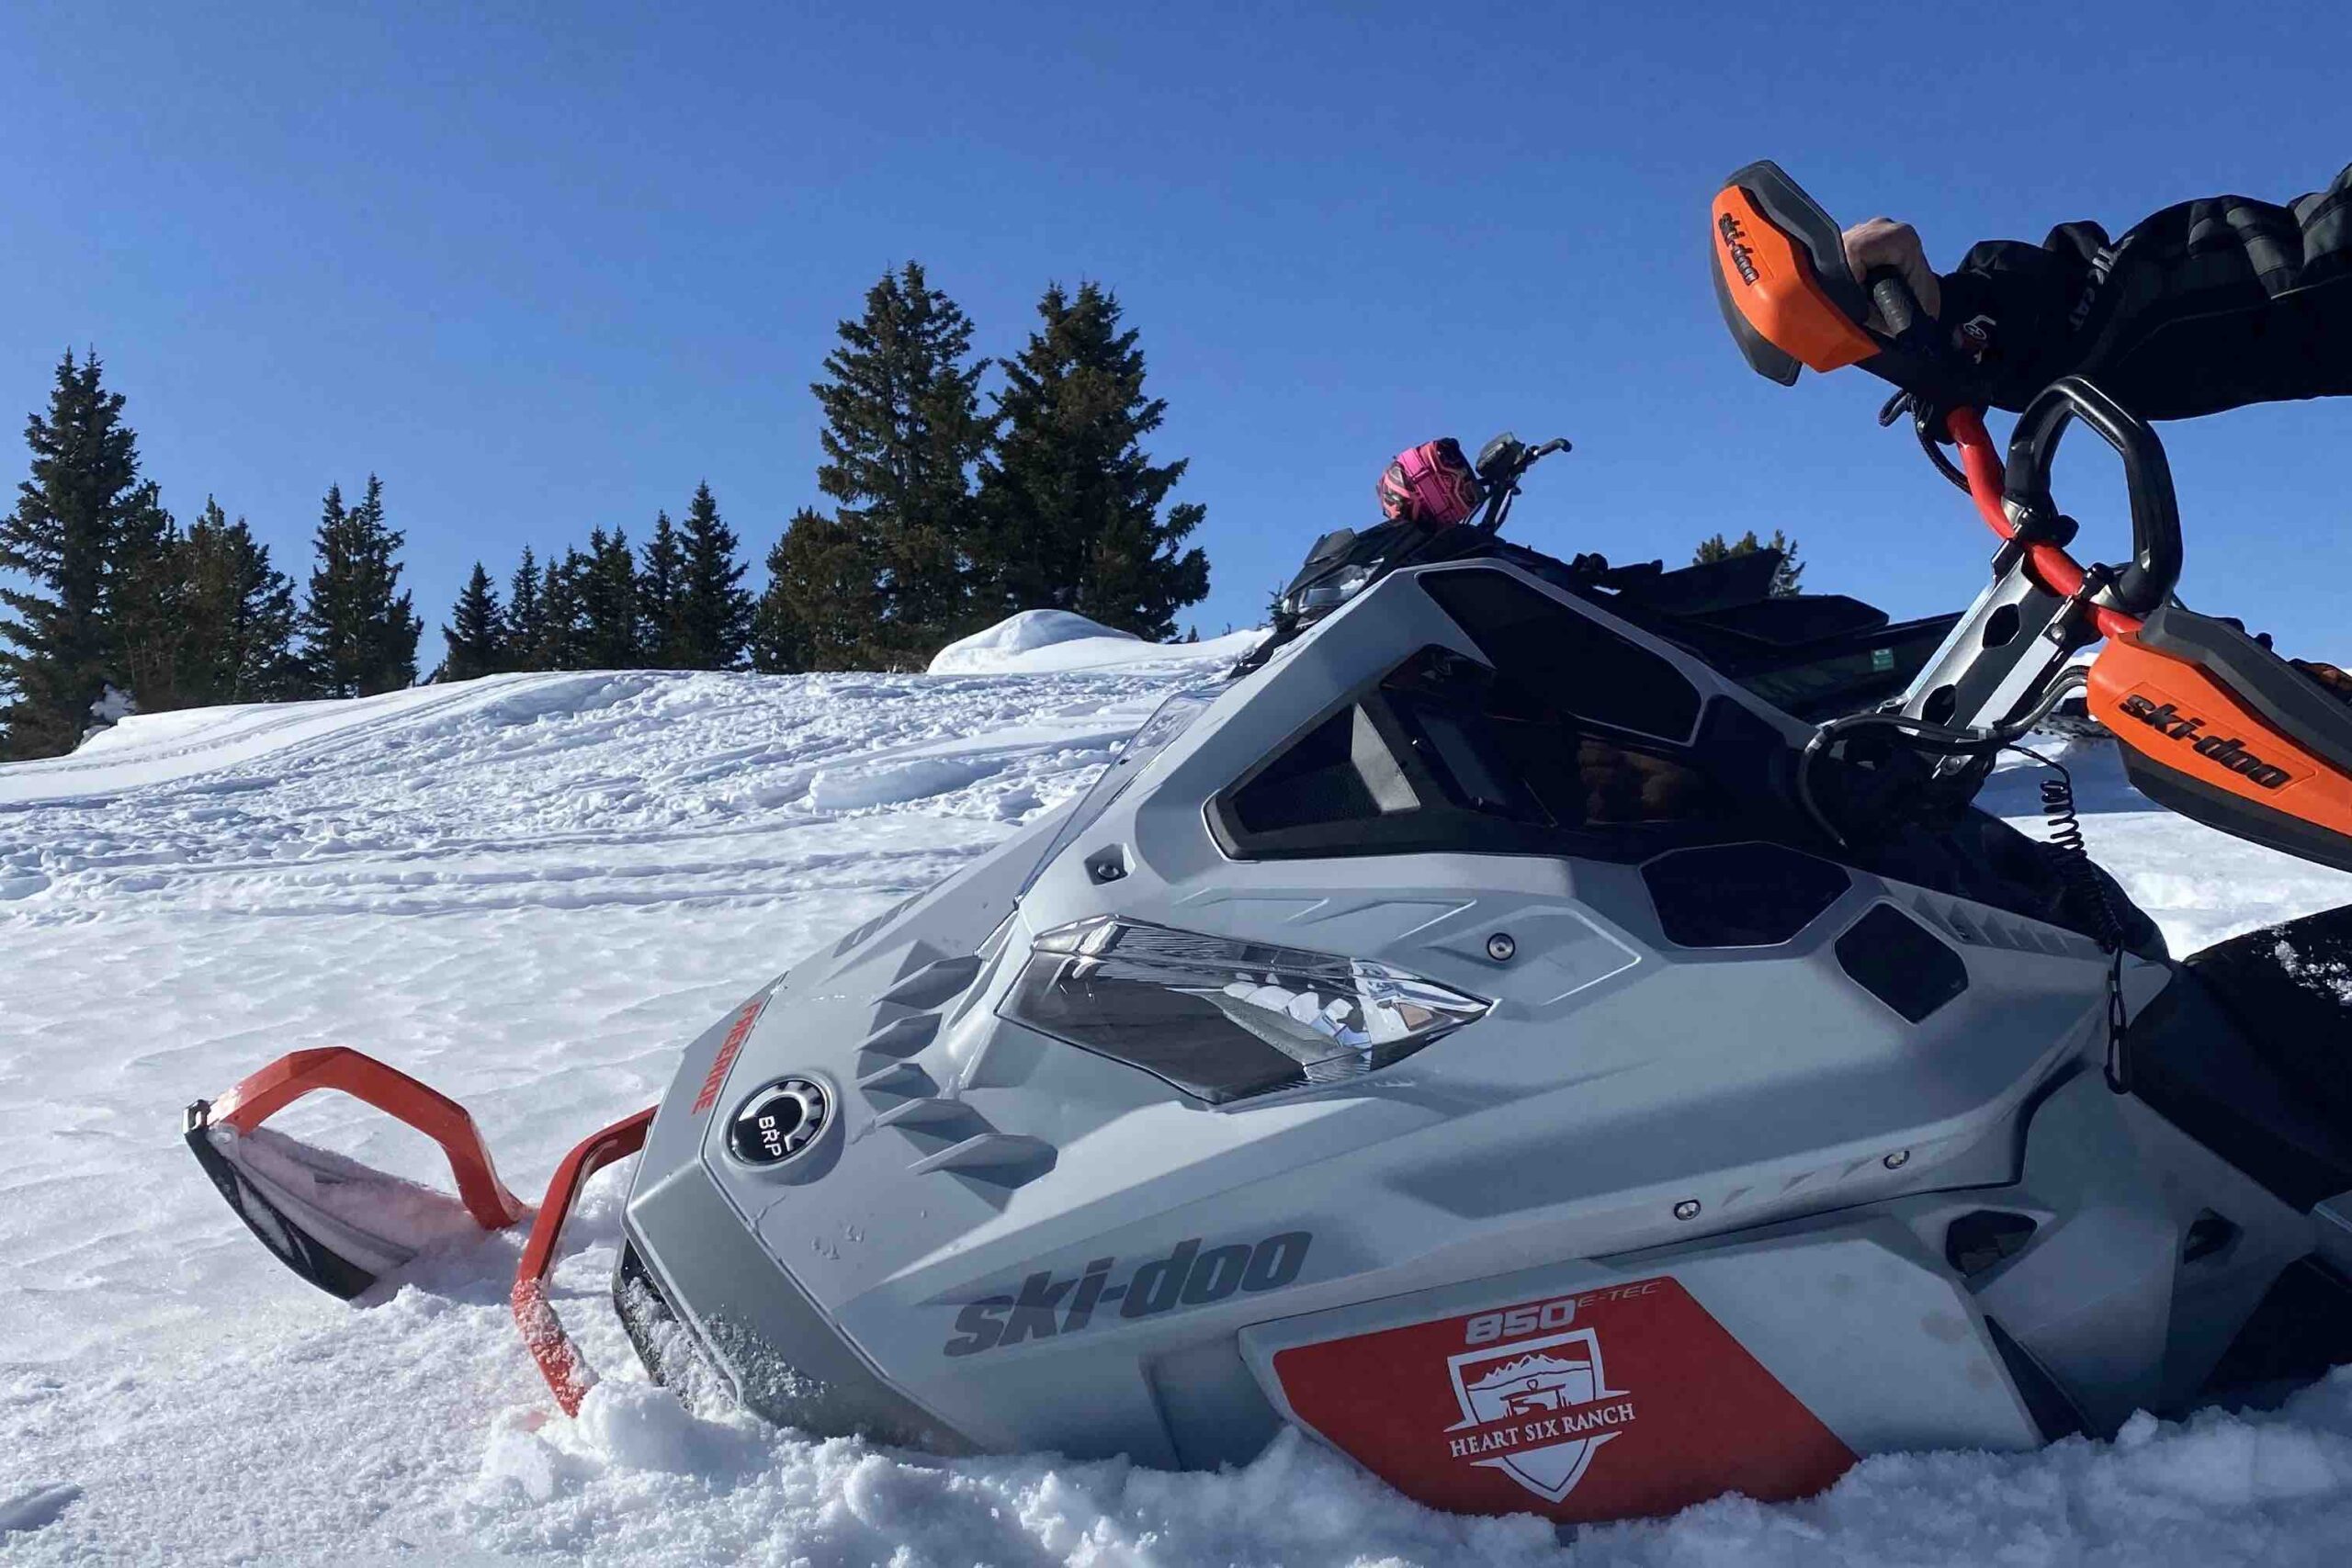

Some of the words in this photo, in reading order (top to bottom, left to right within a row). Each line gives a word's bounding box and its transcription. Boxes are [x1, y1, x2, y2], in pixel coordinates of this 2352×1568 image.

[1718, 212, 1760, 287] ski-doo
[2118, 694, 2292, 790] ski-doo
[758, 1114, 783, 1157] BRP
[943, 1230, 1313, 1358] ski-doo
[1465, 1298, 1576, 1345] 850
[1577, 1280, 1662, 1309] E-TEC
[1449, 1427, 1520, 1458] HEART
[1525, 1417, 1557, 1443] SIX
[1561, 1402, 1636, 1435] RANCH
